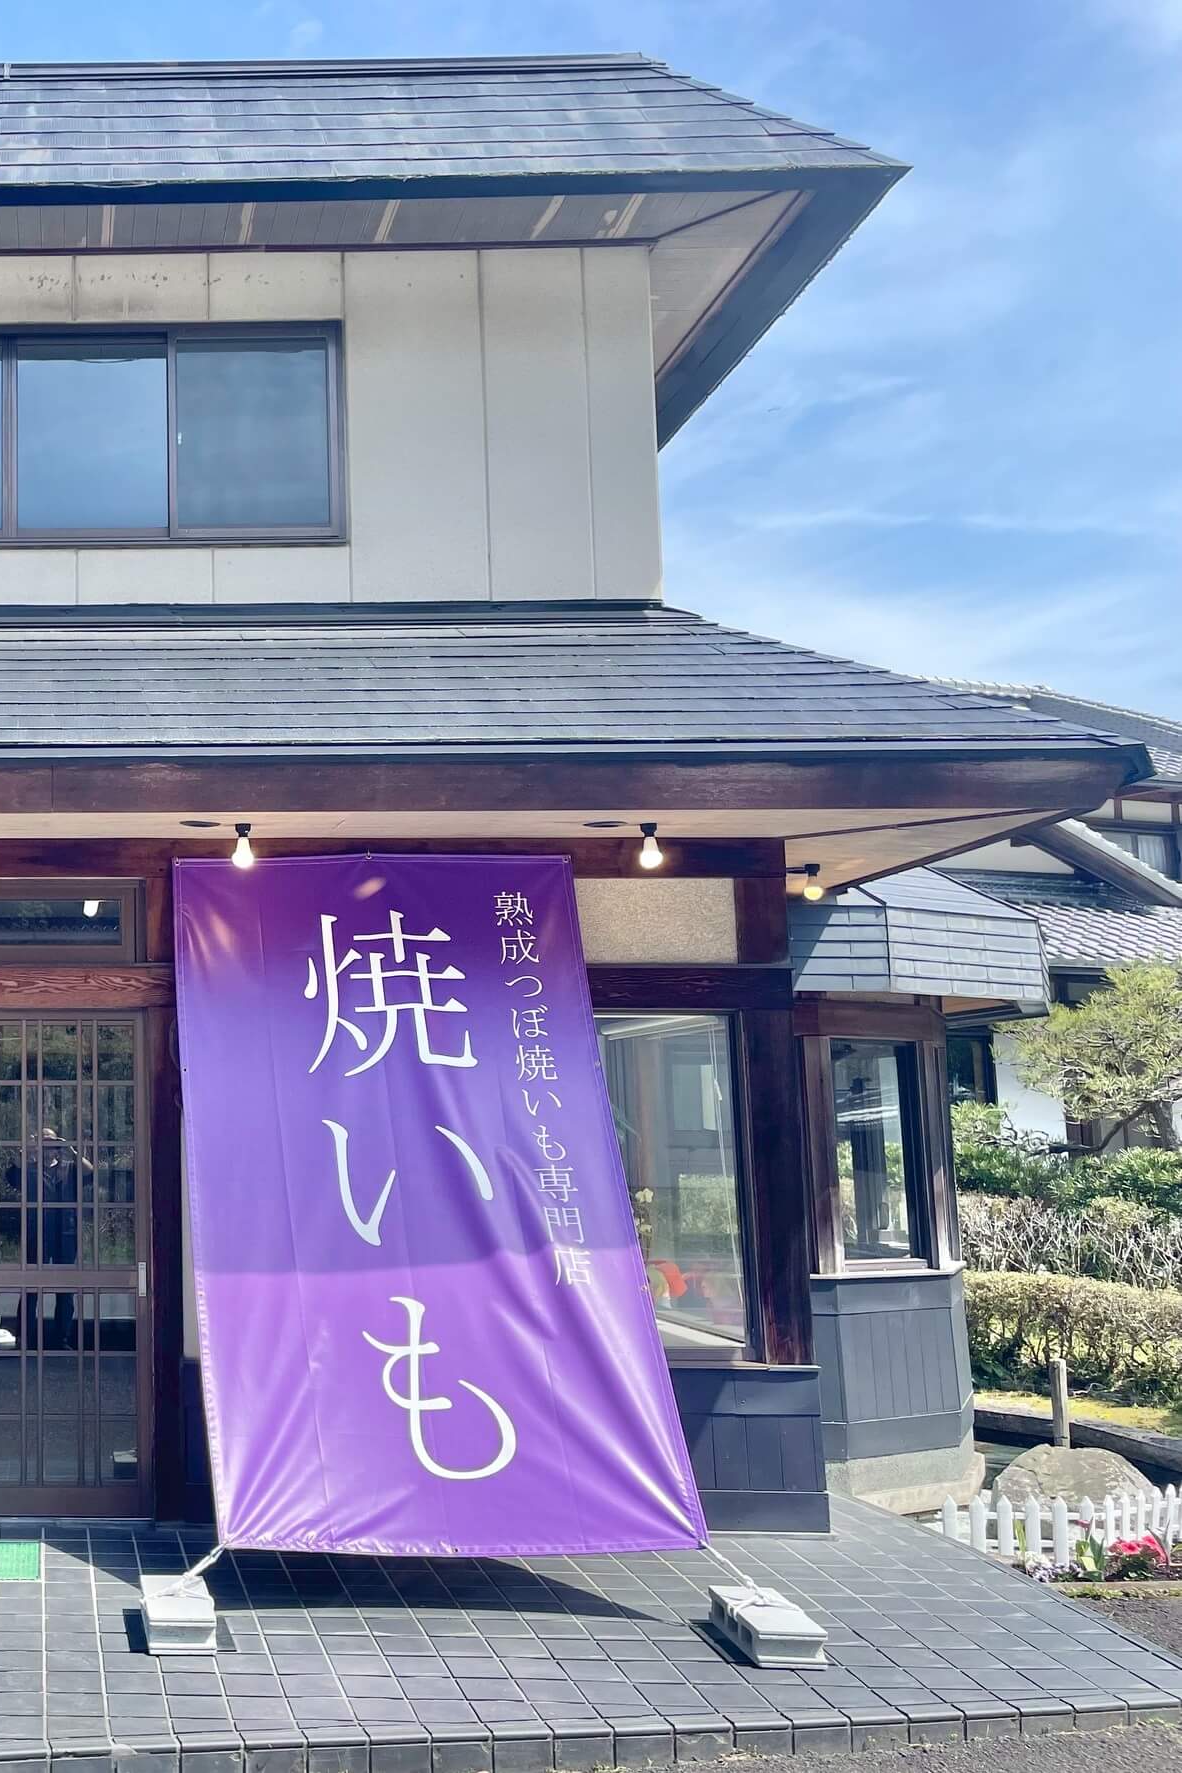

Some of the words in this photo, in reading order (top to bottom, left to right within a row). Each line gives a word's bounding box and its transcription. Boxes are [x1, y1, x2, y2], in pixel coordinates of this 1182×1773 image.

[303, 909, 517, 1480] 焼いも
[493, 890, 592, 1287] 熟成つぼ焼いも専門店
